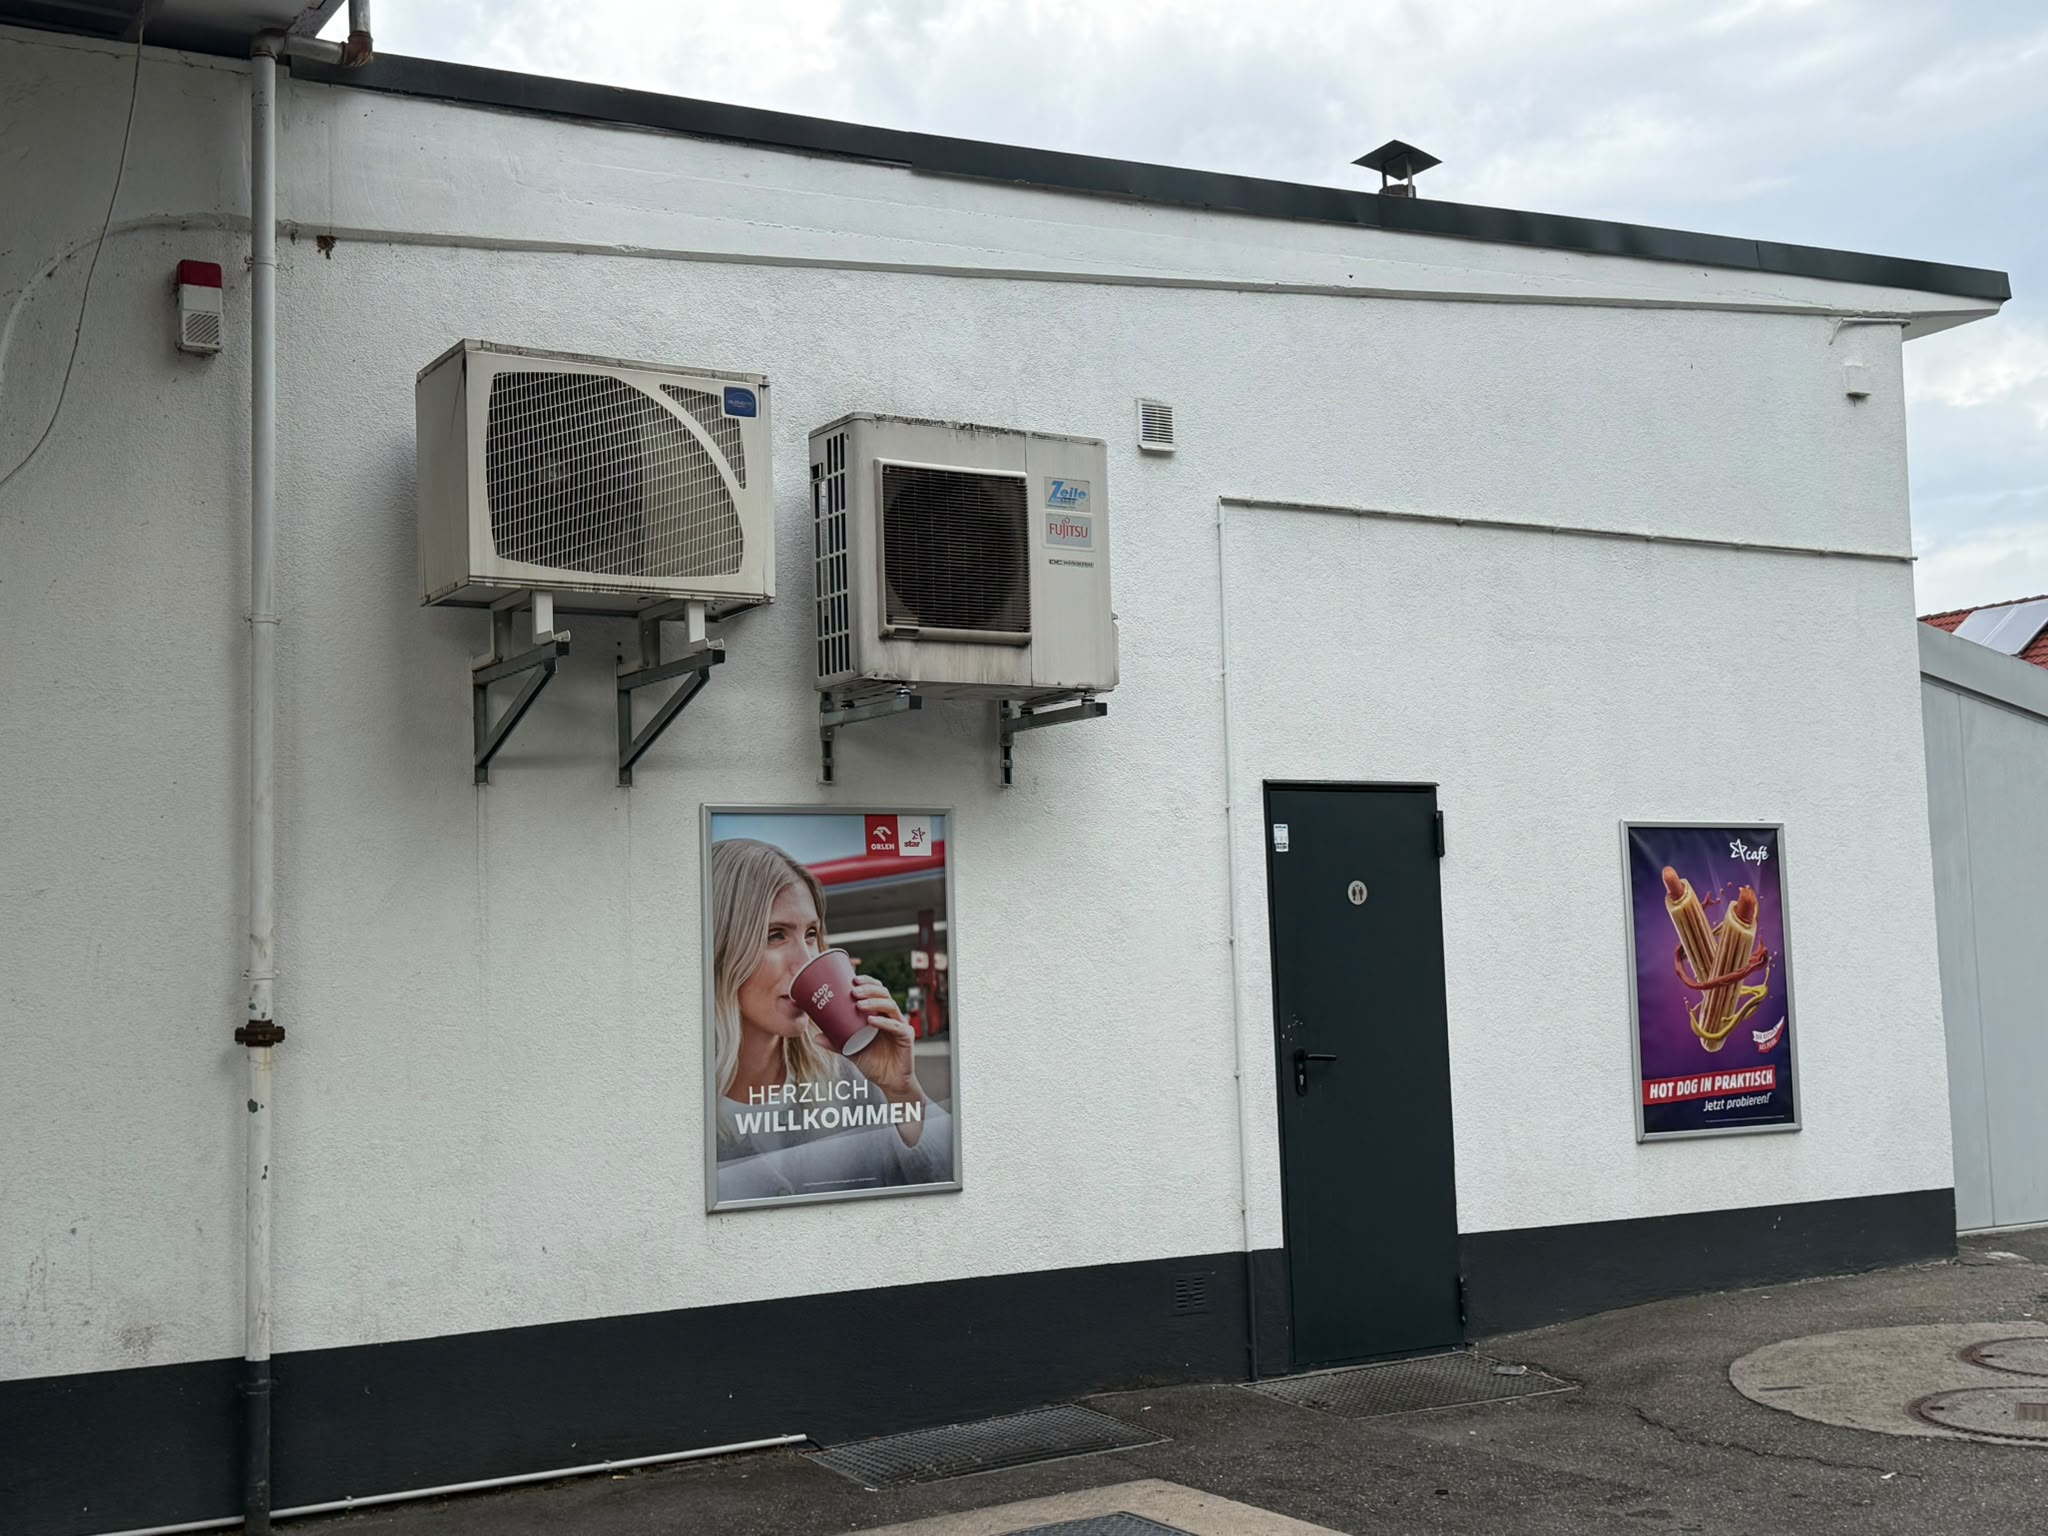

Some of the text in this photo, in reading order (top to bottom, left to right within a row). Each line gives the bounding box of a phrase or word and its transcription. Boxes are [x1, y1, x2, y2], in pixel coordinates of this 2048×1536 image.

[1048, 480, 1088, 503] Zeile
[1049, 517, 1089, 540] FUJITSU
[870, 843, 896, 851] ORLEN
[903, 840, 921, 848] star
[1745, 845, 1770, 867] café
[811, 983, 829, 1004] stop
[748, 1079, 869, 1106] HERZLICH
[1649, 1069, 1774, 1099] HOT DOG IN PRAKTISCH
[1703, 1092, 1773, 1112] Jetzt probieren!
[735, 1101, 922, 1135] WILLKOMMEN
